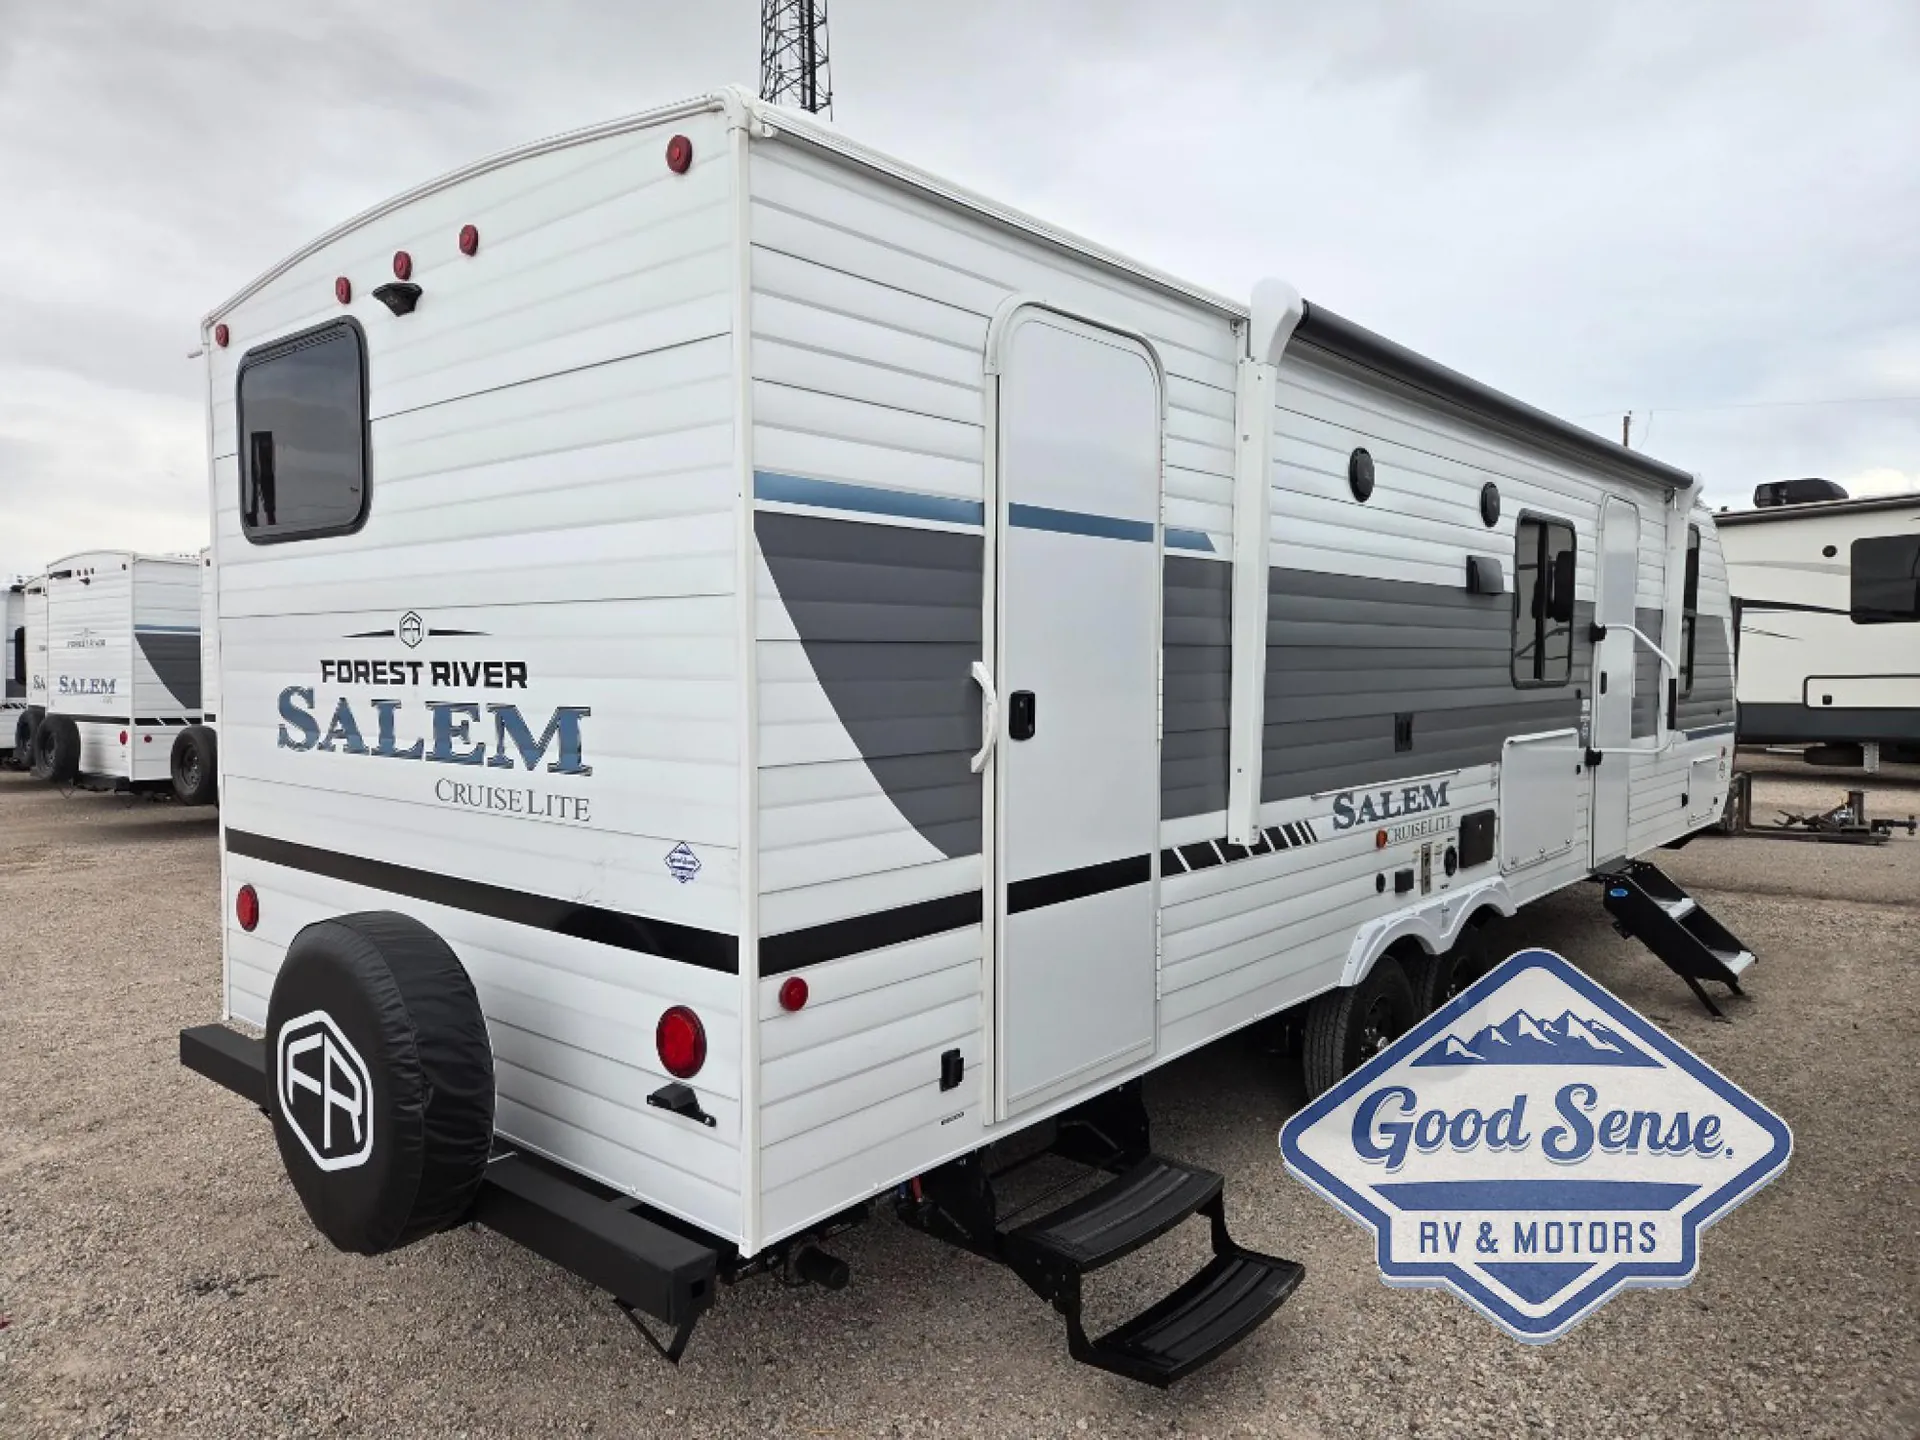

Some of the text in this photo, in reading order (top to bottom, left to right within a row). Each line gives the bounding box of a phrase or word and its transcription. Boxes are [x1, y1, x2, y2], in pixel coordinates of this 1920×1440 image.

[58, 675, 116, 695] SALEM
[320, 659, 528, 689] FOREST RIVER
[277, 685, 592, 777] SALEM
[1332, 780, 1450, 830] SALEM
